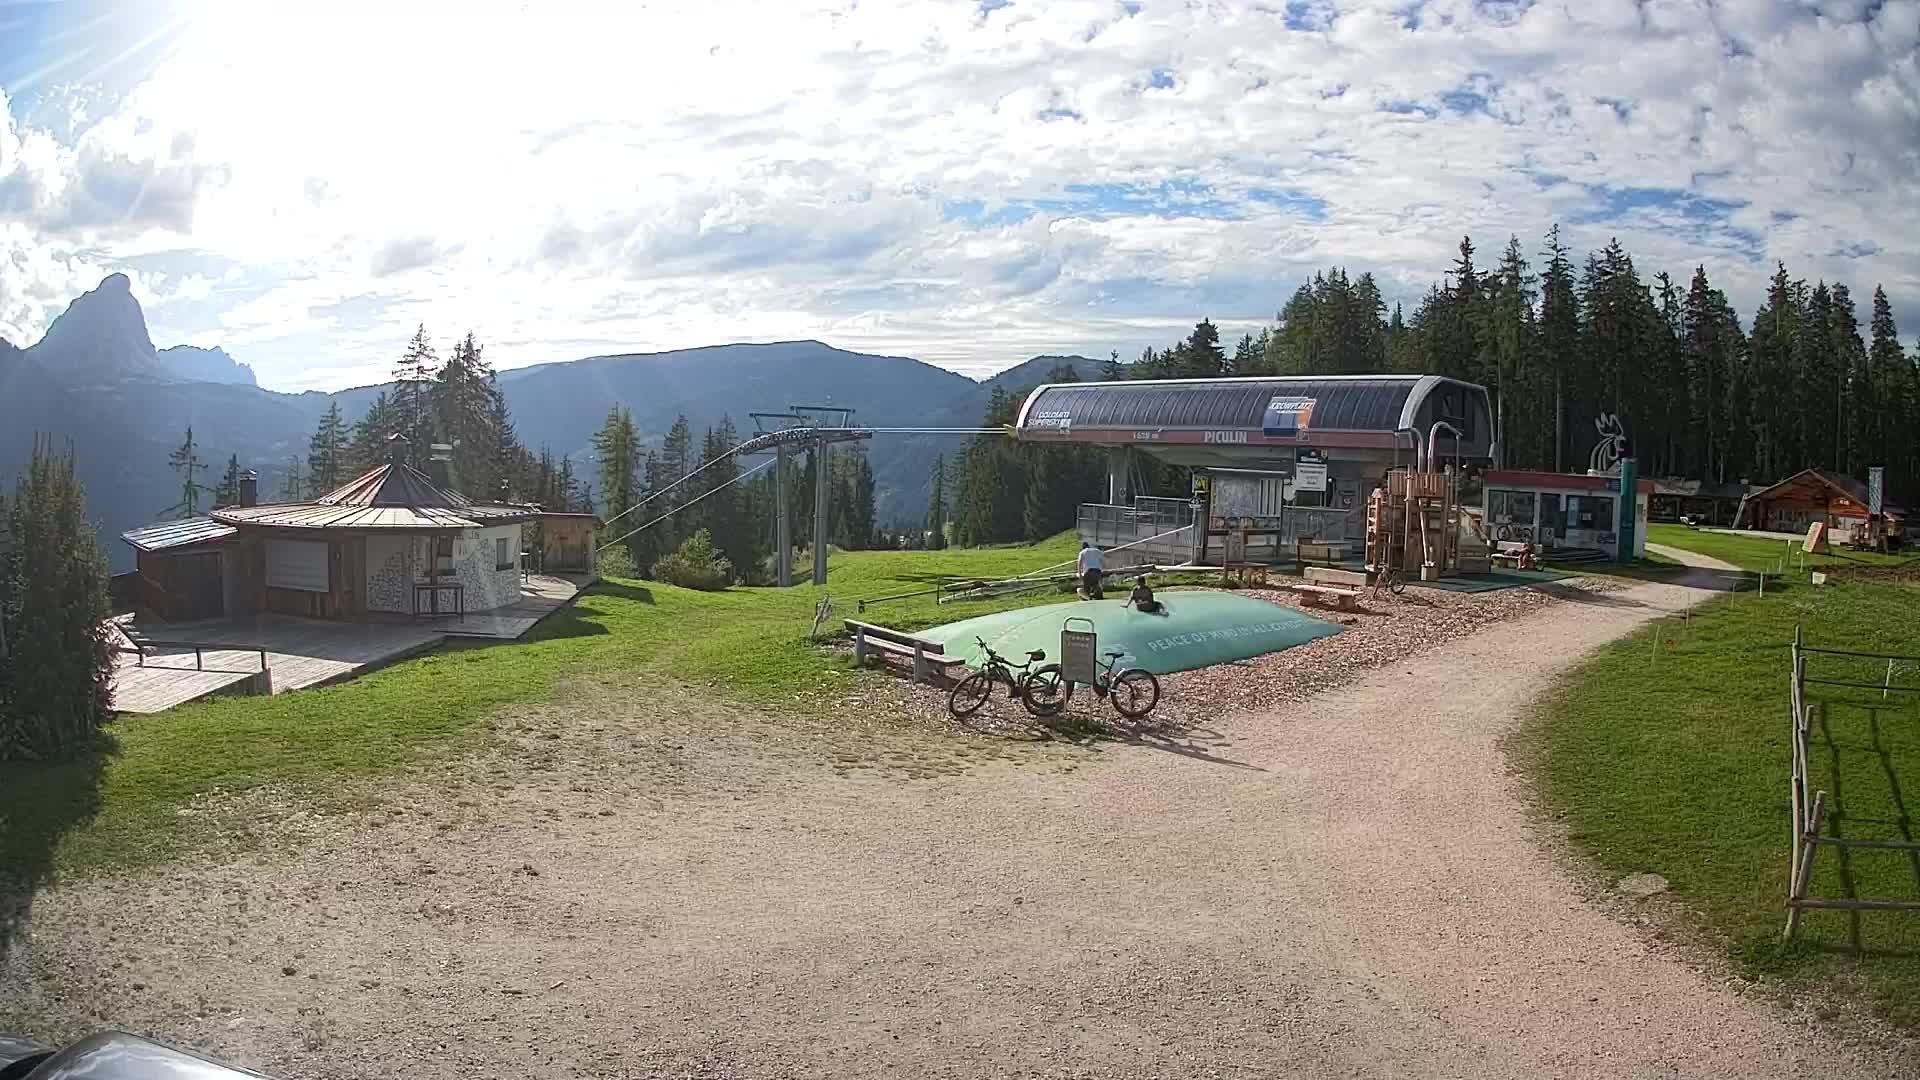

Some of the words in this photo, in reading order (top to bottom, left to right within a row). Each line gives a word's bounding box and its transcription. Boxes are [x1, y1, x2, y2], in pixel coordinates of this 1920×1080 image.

[1204, 430, 1248, 443] PICULIN
[1147, 634, 1192, 652] PEACE
[1191, 632, 1207, 643] OF
